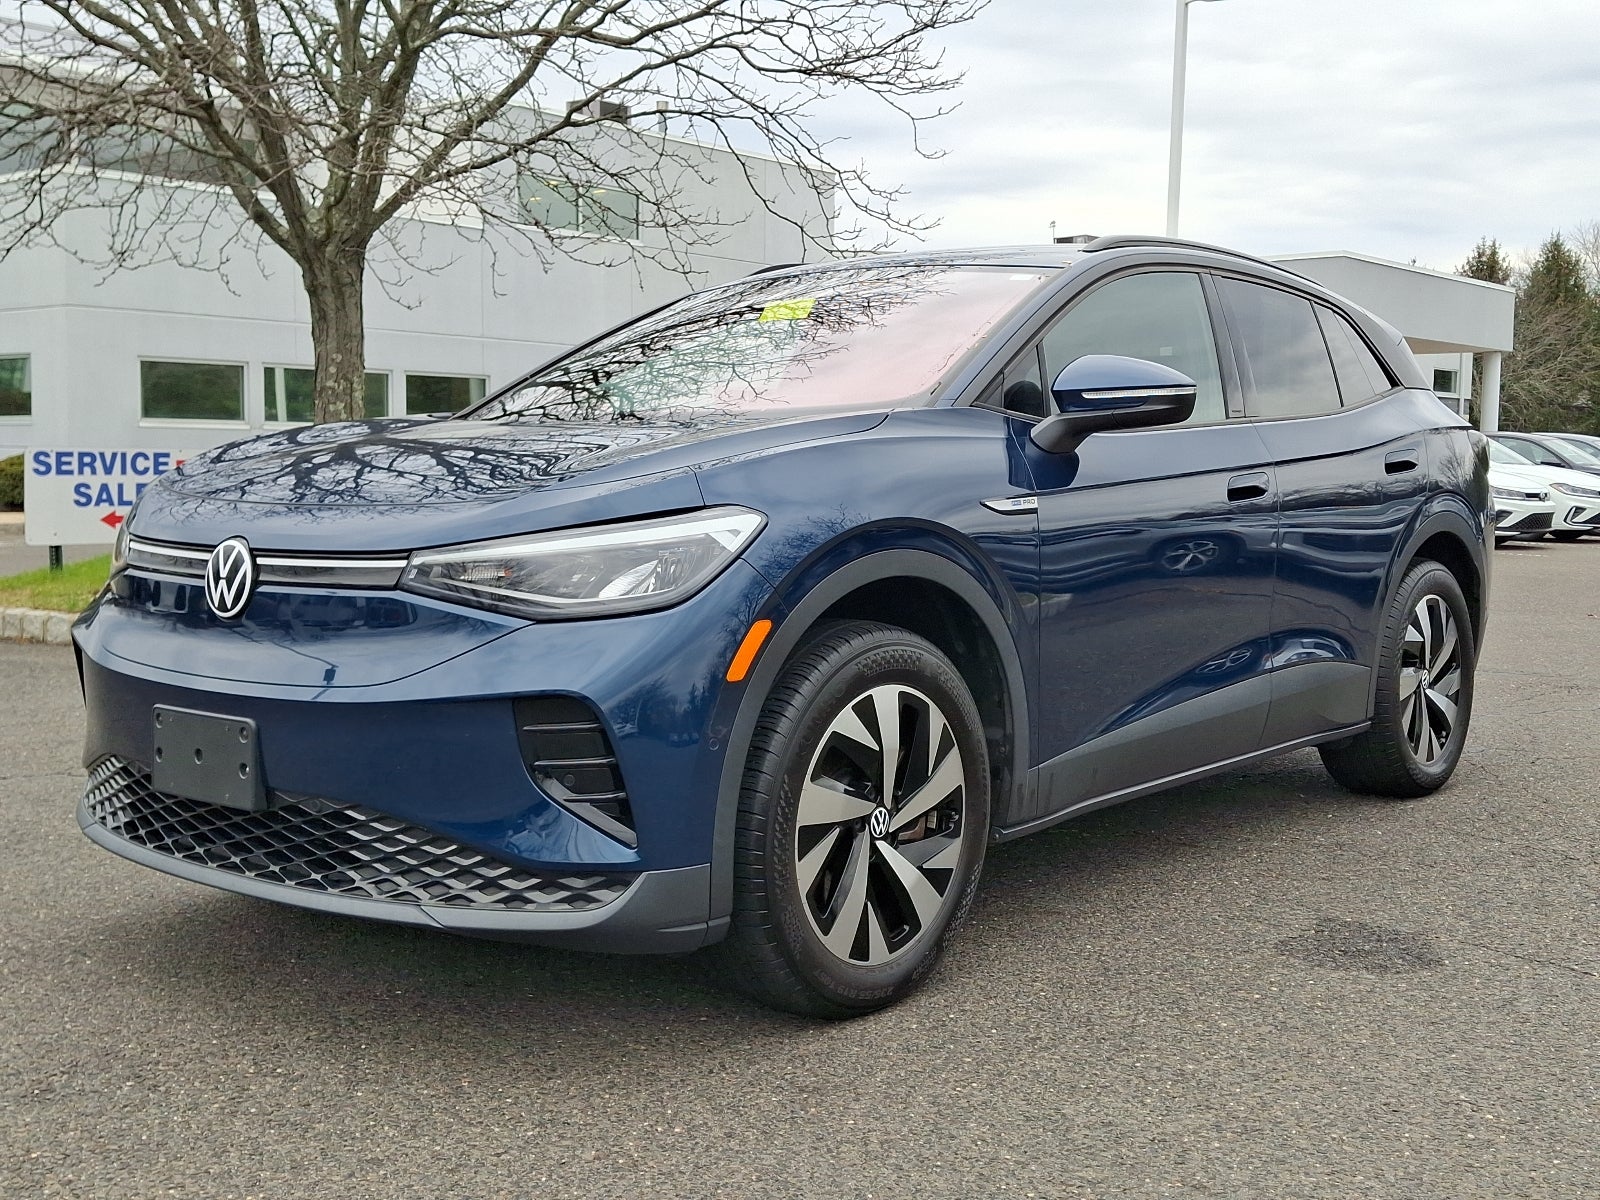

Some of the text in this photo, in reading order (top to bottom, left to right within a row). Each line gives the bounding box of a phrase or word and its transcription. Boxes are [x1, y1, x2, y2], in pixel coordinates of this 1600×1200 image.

[32, 451, 171, 476] SERVICE
[205, 539, 252, 618] VW
[871, 806, 890, 838] VW
